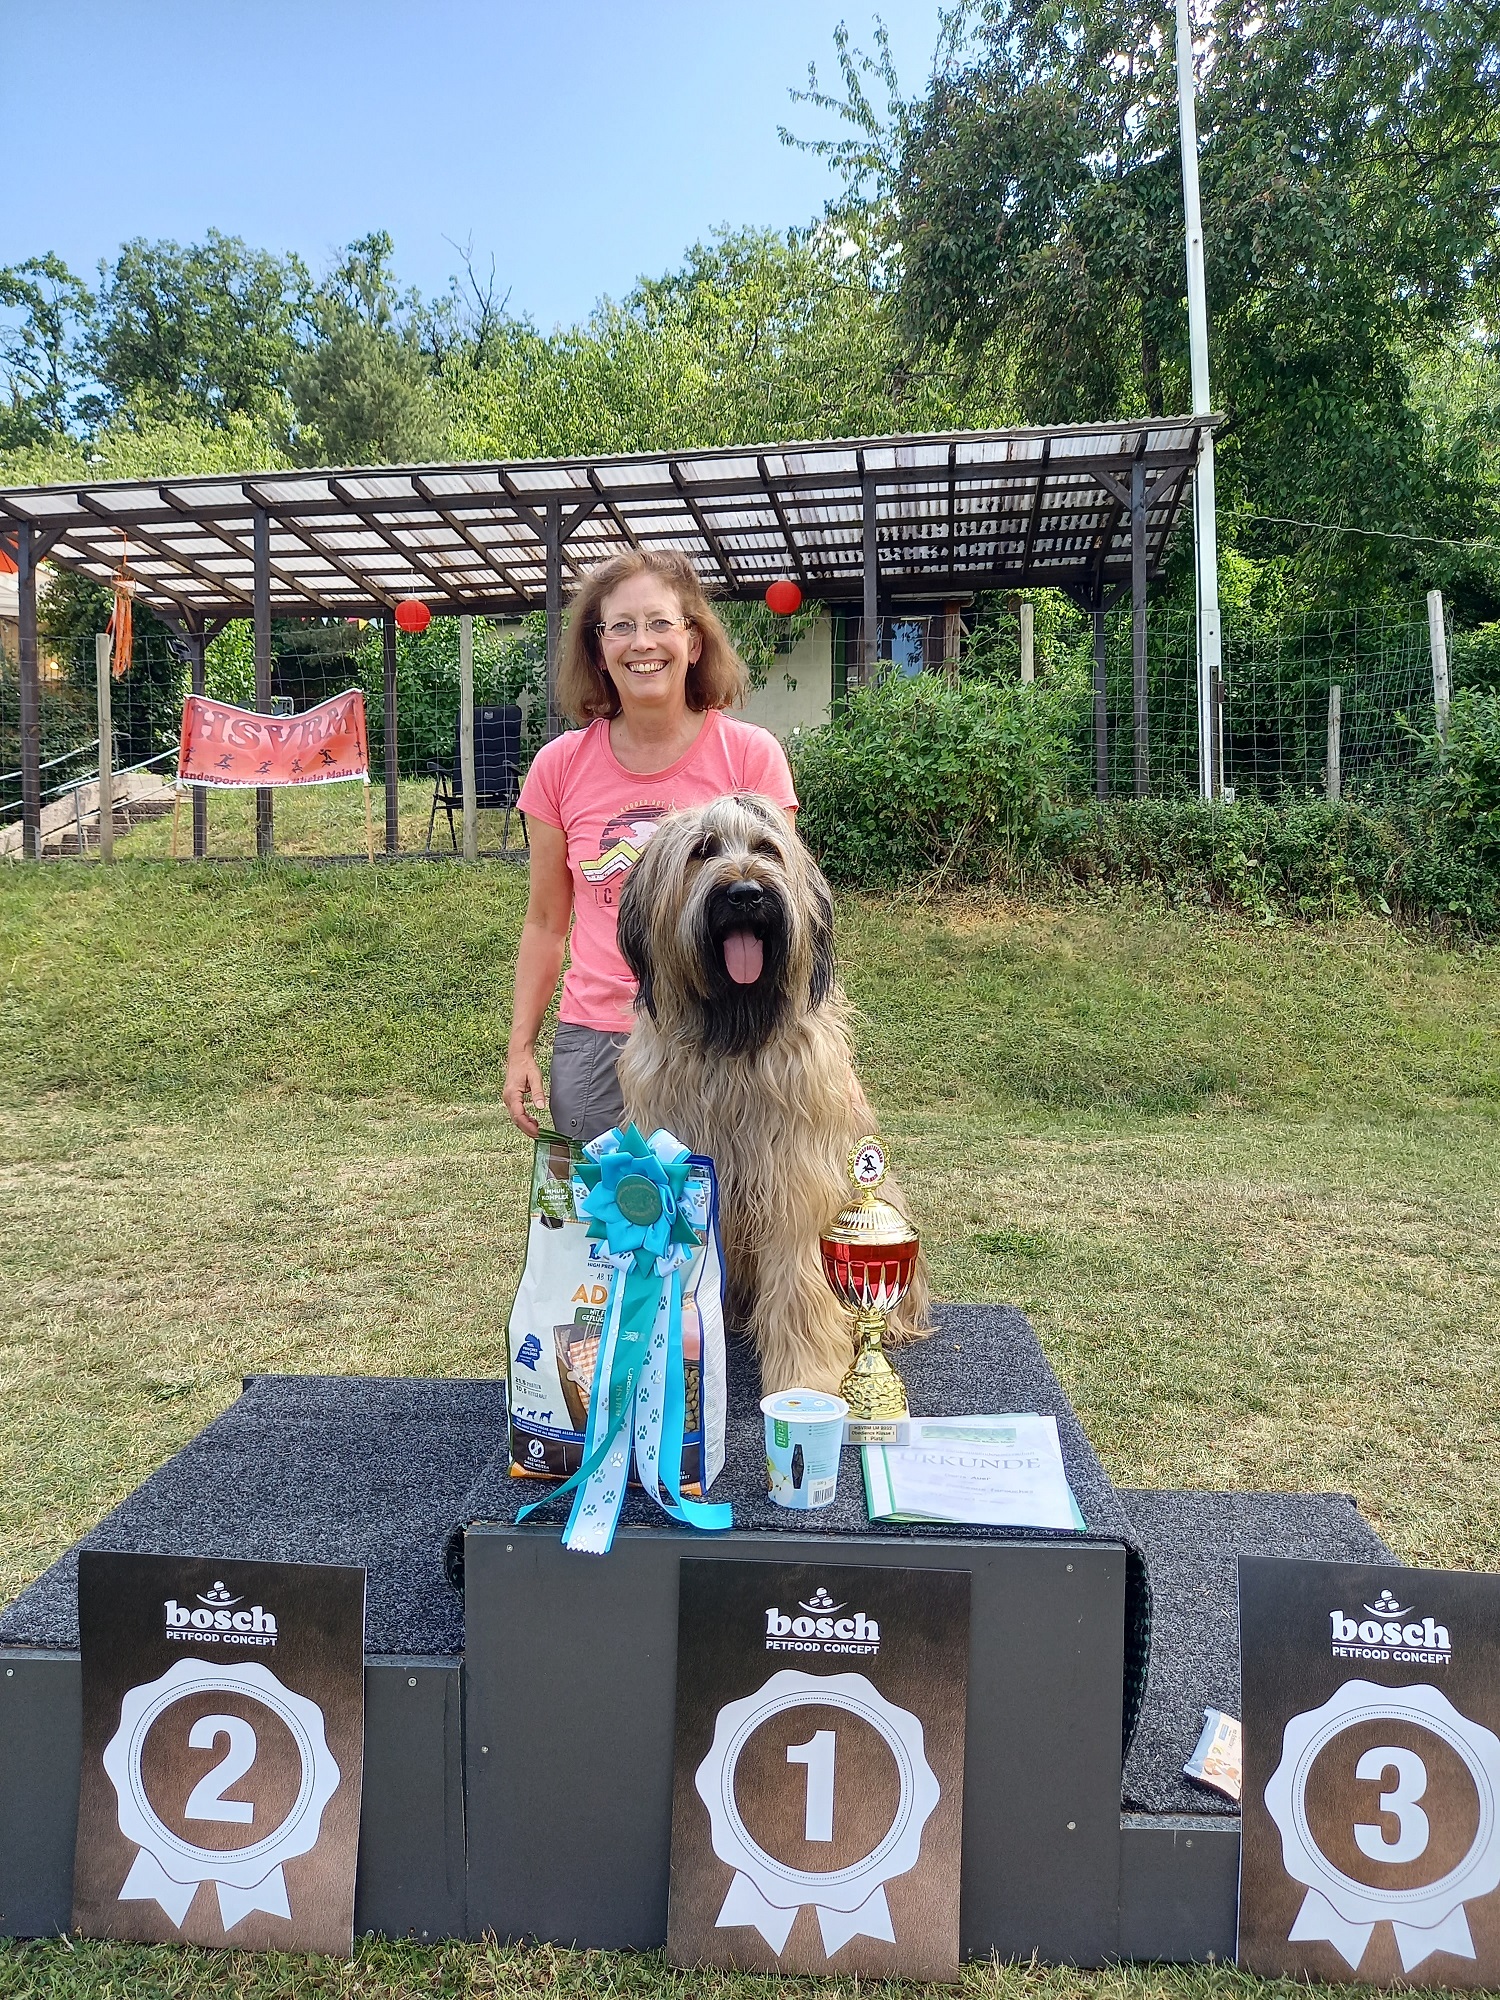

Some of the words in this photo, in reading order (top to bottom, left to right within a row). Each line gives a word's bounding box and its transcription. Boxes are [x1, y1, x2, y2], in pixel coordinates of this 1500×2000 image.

[191, 700, 355, 752] HSVRM
[326, 768, 353, 780] Main
[900, 1453, 1041, 1470] URKUNDE
[164, 1600, 278, 1633] bosch
[765, 1607, 881, 1641] bosch
[1329, 1610, 1452, 1649] bosch
[166, 1631, 220, 1642] PETFOOD
[223, 1634, 278, 1646] CONCEPT
[766, 1641, 821, 1652] PETFOOD
[823, 1643, 880, 1655] CONCEPT
[1332, 1646, 1390, 1660] PETFOOD
[1392, 1651, 1452, 1665] CONCEPT
[184, 1714, 257, 1824] 2
[786, 1730, 836, 1842] 1
[1353, 1746, 1430, 1863] 3
